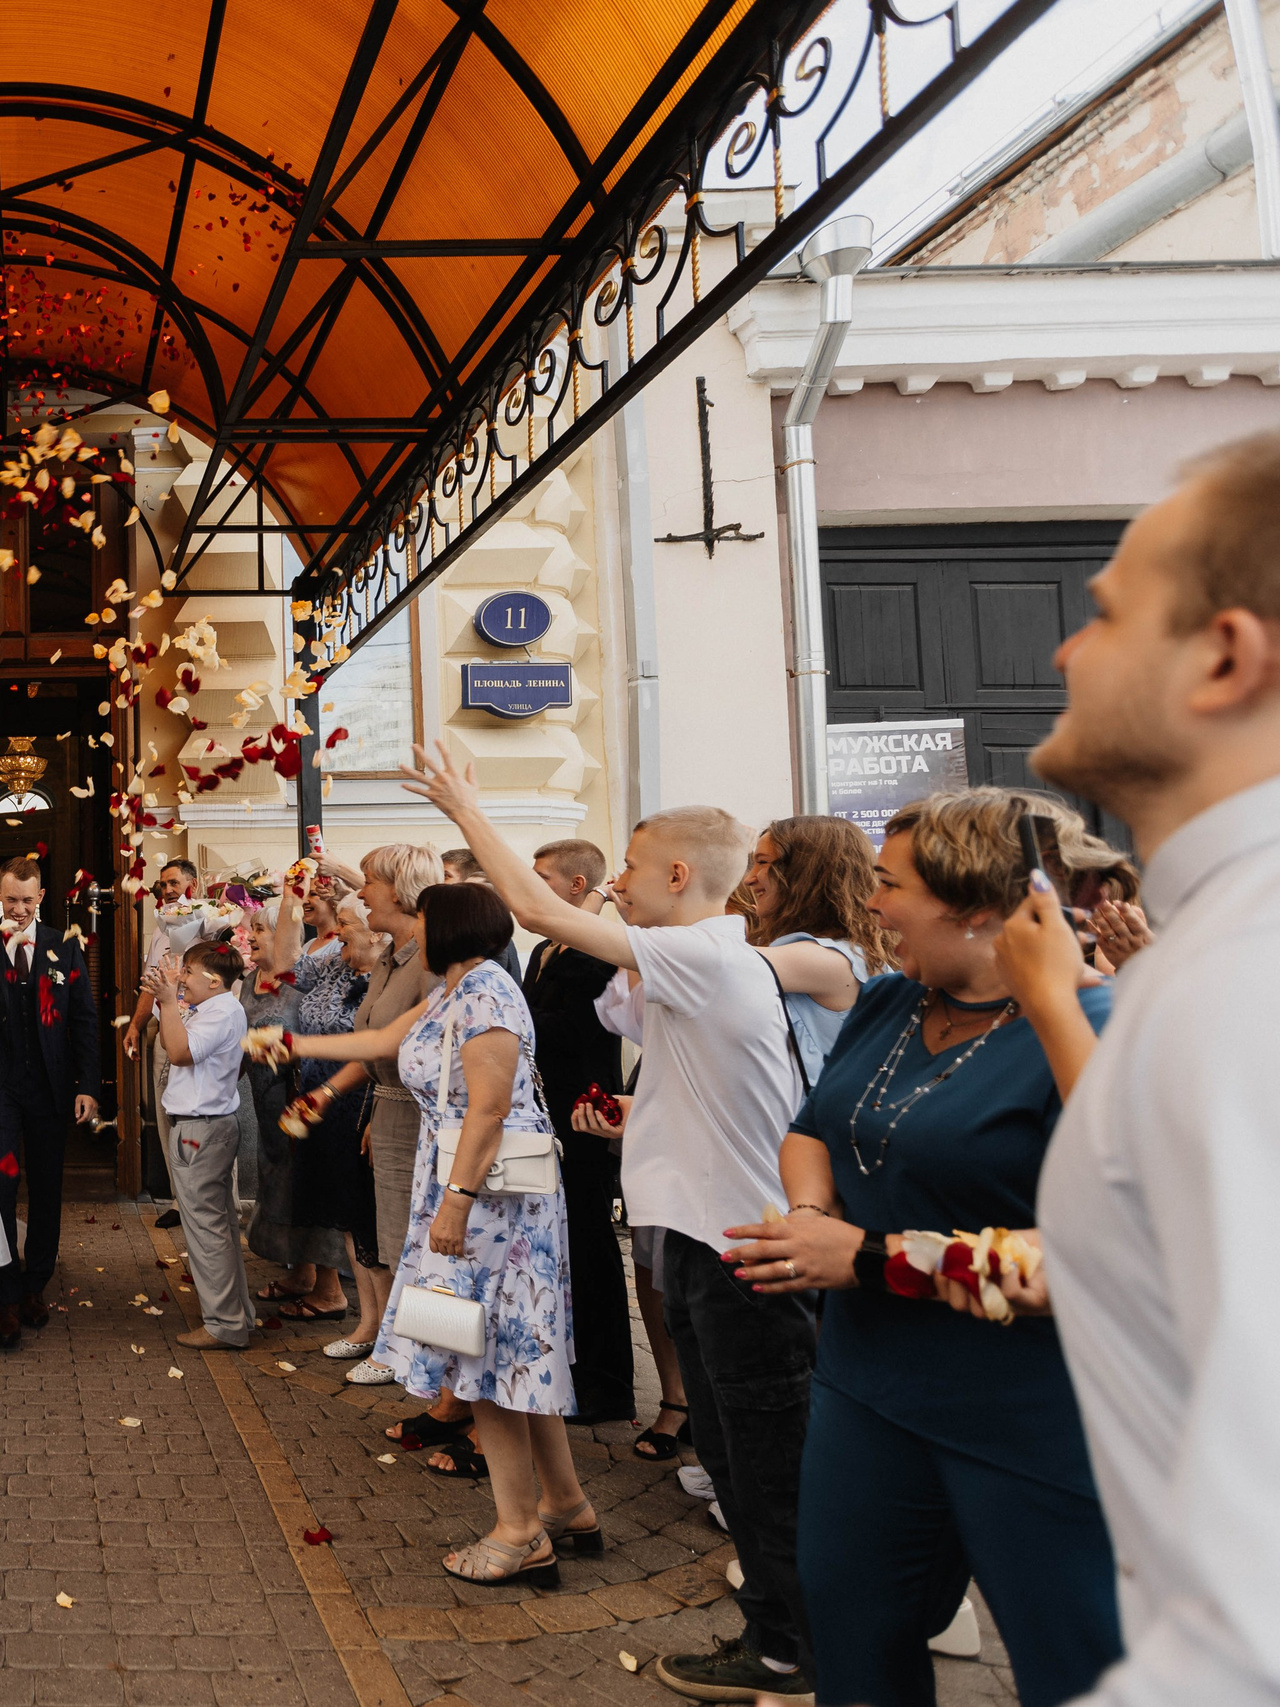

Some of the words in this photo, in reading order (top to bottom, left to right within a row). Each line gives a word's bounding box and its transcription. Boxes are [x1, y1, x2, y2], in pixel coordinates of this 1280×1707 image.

[504, 607, 527, 629] 11
[474, 680, 522, 689] ПЛОЩАДЬ
[525, 679, 565, 688] ЛЕНИНА
[508, 703, 532, 711] УЛИЦА
[827, 732, 953, 756] МУЖСКАЯ
[828, 754, 930, 777] РАБОТА
[831, 780, 867, 788] контракт
[852, 810, 859, 819] 2
[860, 809, 880, 819] 500
